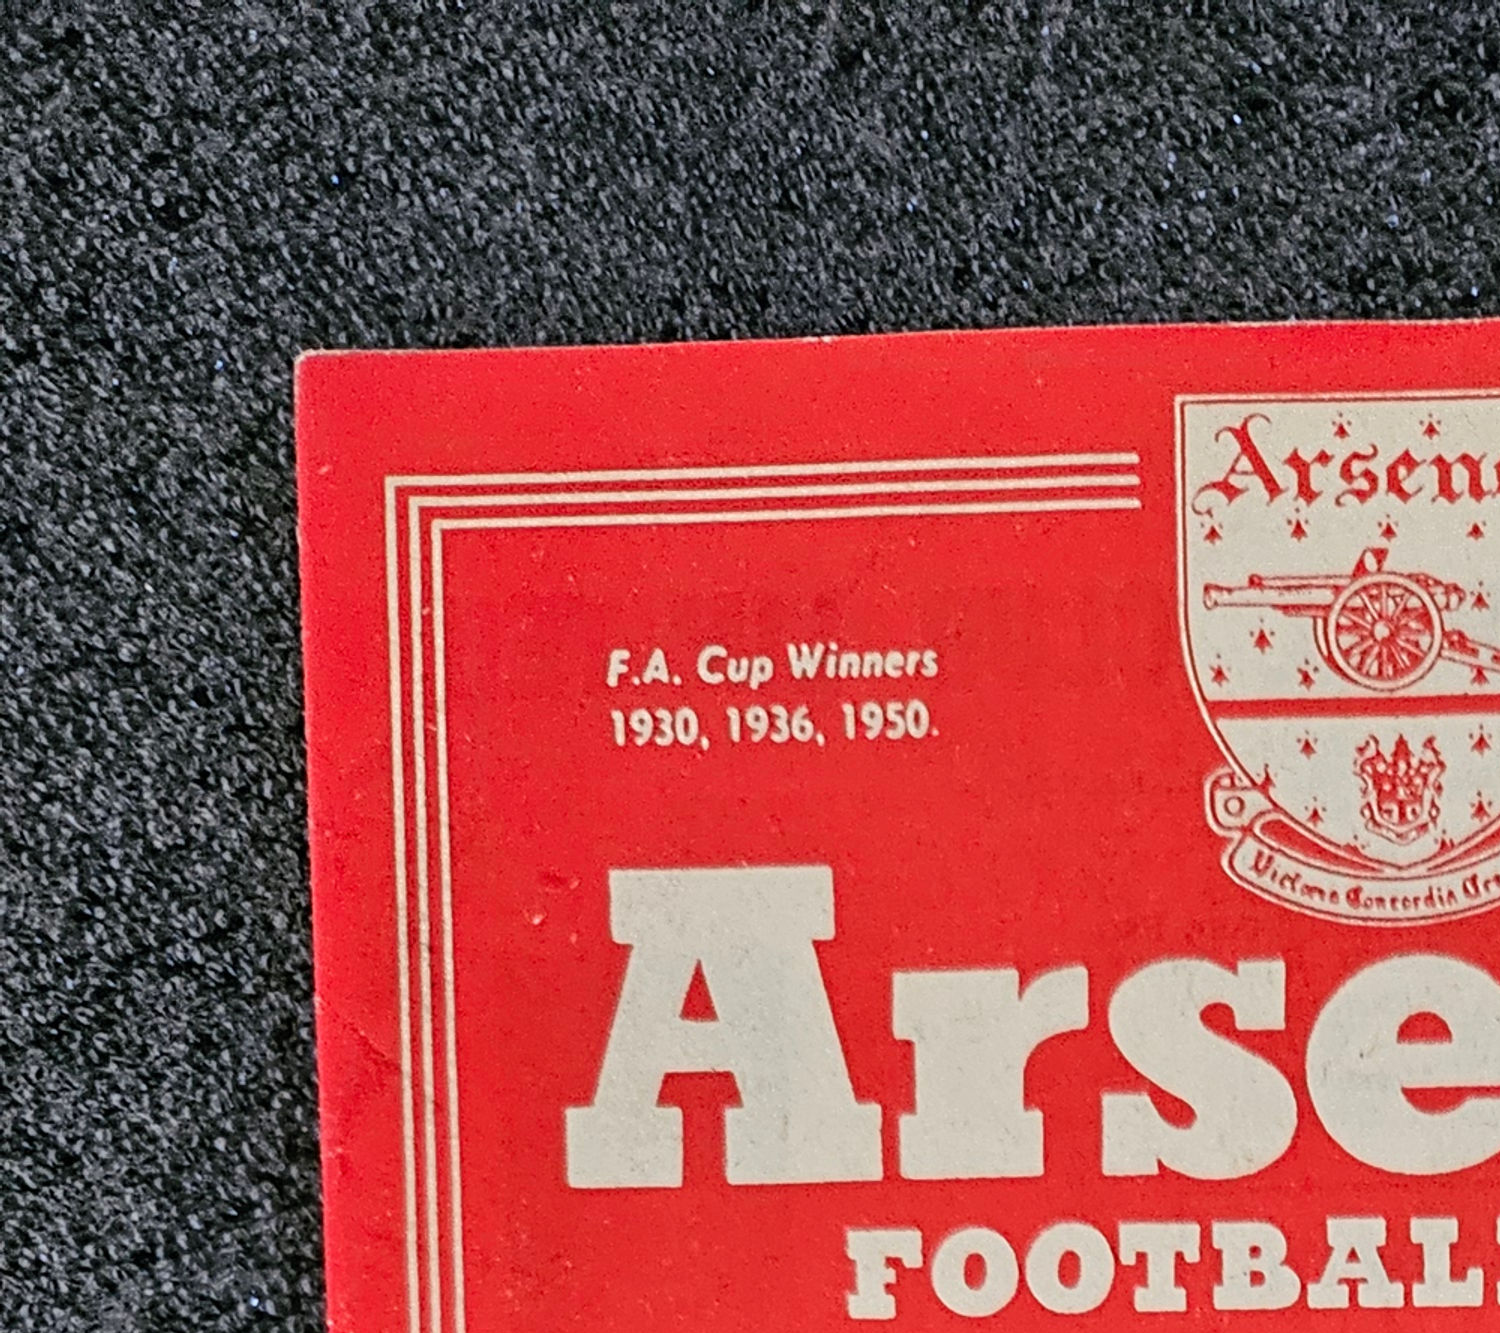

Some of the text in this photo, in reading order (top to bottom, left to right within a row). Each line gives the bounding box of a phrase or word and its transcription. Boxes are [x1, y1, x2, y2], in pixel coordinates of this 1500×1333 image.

[605, 640, 939, 691] F.A. Cup Winners
[610, 697, 940, 752] 1930, 1936, 1950.
